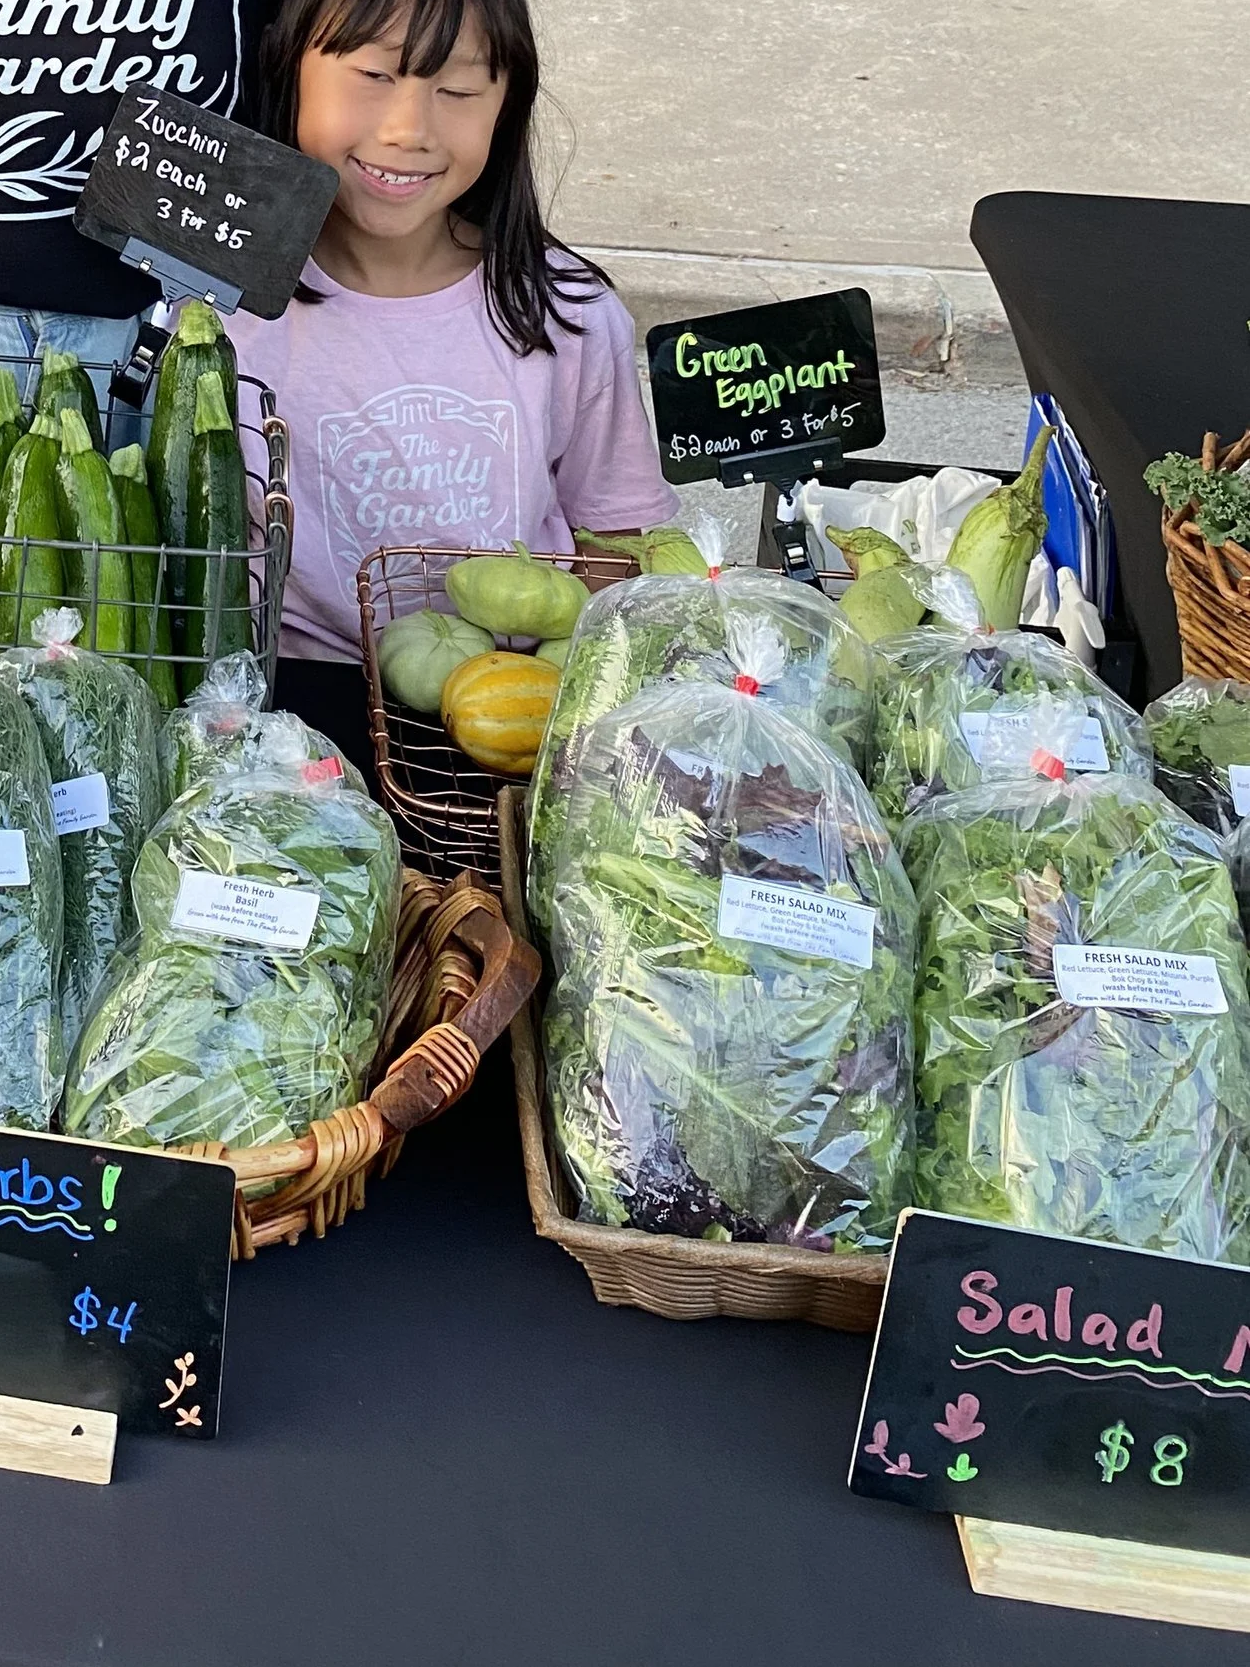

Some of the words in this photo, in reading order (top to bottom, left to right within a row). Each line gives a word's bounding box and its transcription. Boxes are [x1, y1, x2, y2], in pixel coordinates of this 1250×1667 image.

[133, 95, 229, 165] Zucchini
[114, 134, 151, 172] $2
[154, 157, 208, 197] each
[223, 192, 248, 211] or
[155, 196, 174, 220] 3
[213, 220, 253, 250] $5
[675, 331, 768, 379] Green
[715, 349, 857, 418] Eggplant
[400, 432, 442, 460] The
[750, 428, 769, 445] or
[779, 418, 795, 440] 3
[349, 442, 492, 495] Family
[355, 489, 494, 538] Garden
[53, 787, 68, 798] erb
[223, 880, 250, 894] Fresh
[251, 885, 275, 899] Herb
[235, 894, 259, 908] Basil
[750, 889, 786, 907] FRESH
[788, 897, 824, 915] SALAD
[826, 906, 848, 922] MIX
[1061, 963, 1076, 974] Red
[1107, 966, 1131, 976] Green
[1084, 951, 1122, 965] FRESH
[1124, 954, 1162, 968] SALAD
[1164, 958, 1189, 972] MIX
[1101, 983, 1127, 993] (wash
[1126, 983, 1153, 994] before
[1154, 987, 1183, 999] eating)
[68, 1285, 138, 1344] $4
[956, 1269, 1164, 1359] Salad
